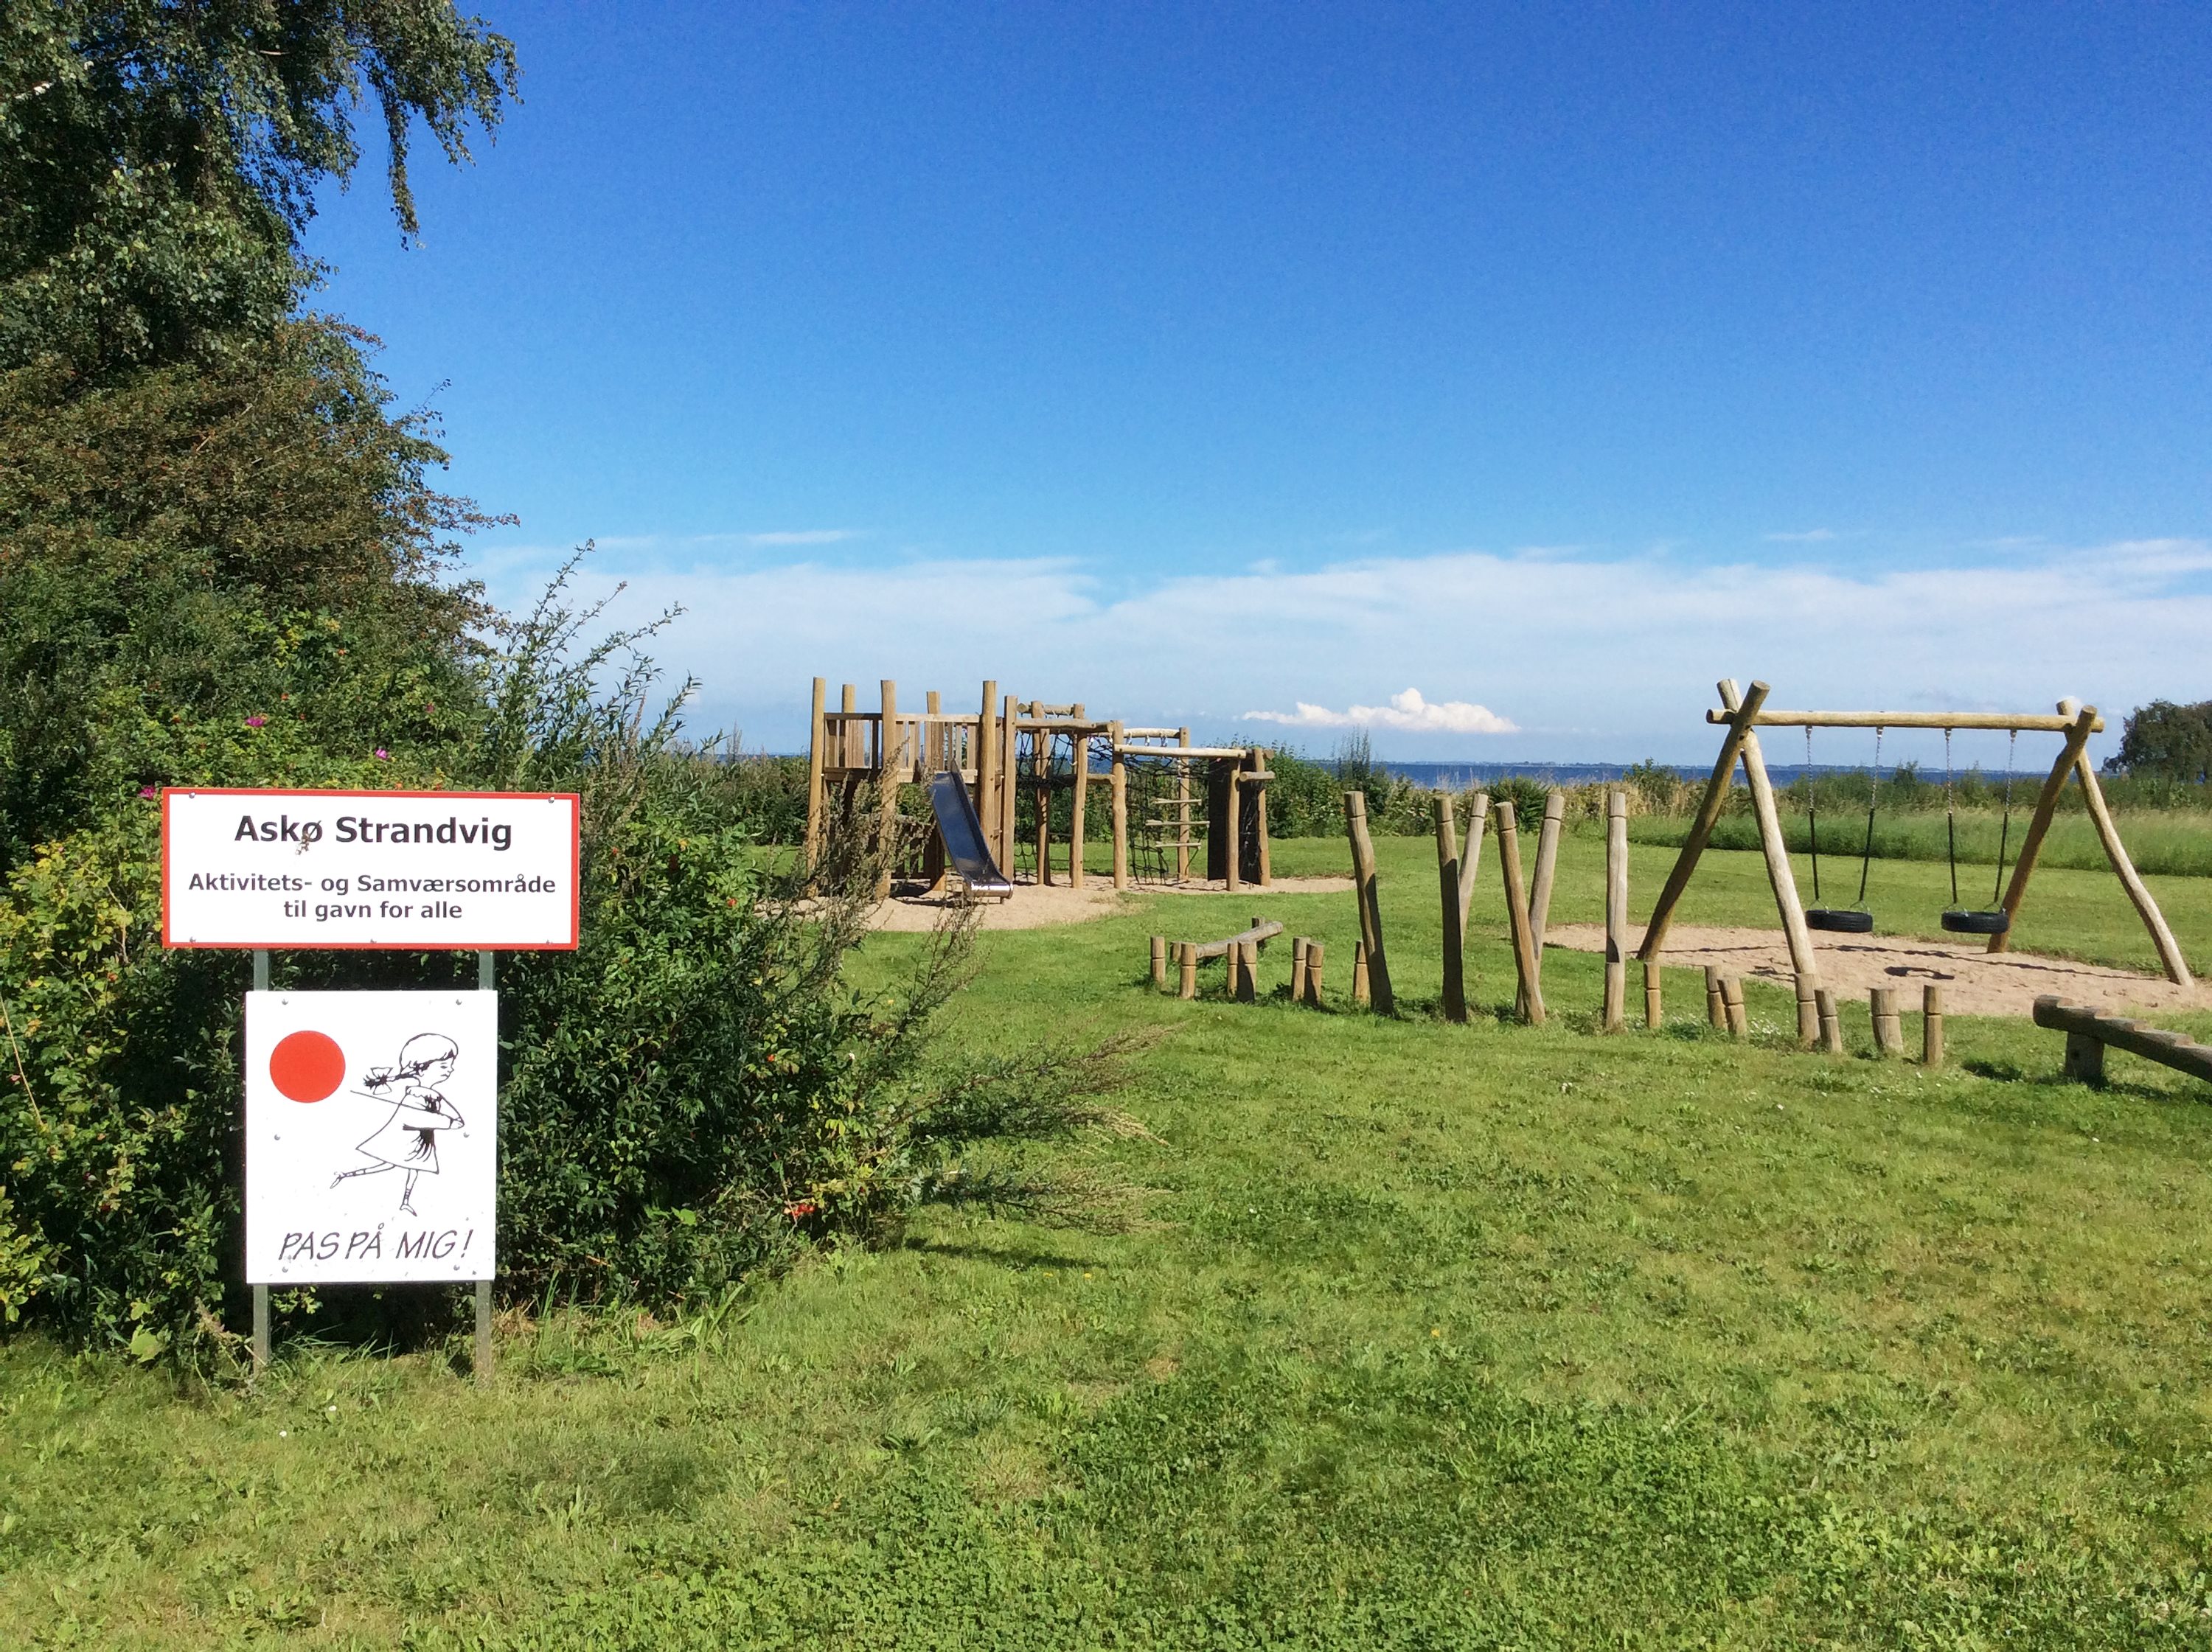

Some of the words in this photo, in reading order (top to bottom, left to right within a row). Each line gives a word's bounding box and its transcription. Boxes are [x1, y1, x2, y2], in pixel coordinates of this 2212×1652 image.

[234, 815, 323, 845] Askø
[335, 816, 512, 851] Strandvig
[188, 873, 312, 892] Aktivitets-
[320, 878, 349, 896] og
[357, 874, 556, 893] Samværsområde
[283, 900, 307, 918] til
[315, 905, 372, 922] gavn
[380, 901, 414, 919] for
[420, 901, 463, 919] alle
[278, 1231, 341, 1261] PAS
[345, 1221, 386, 1260] PÅ
[395, 1229, 475, 1260] MIG!
